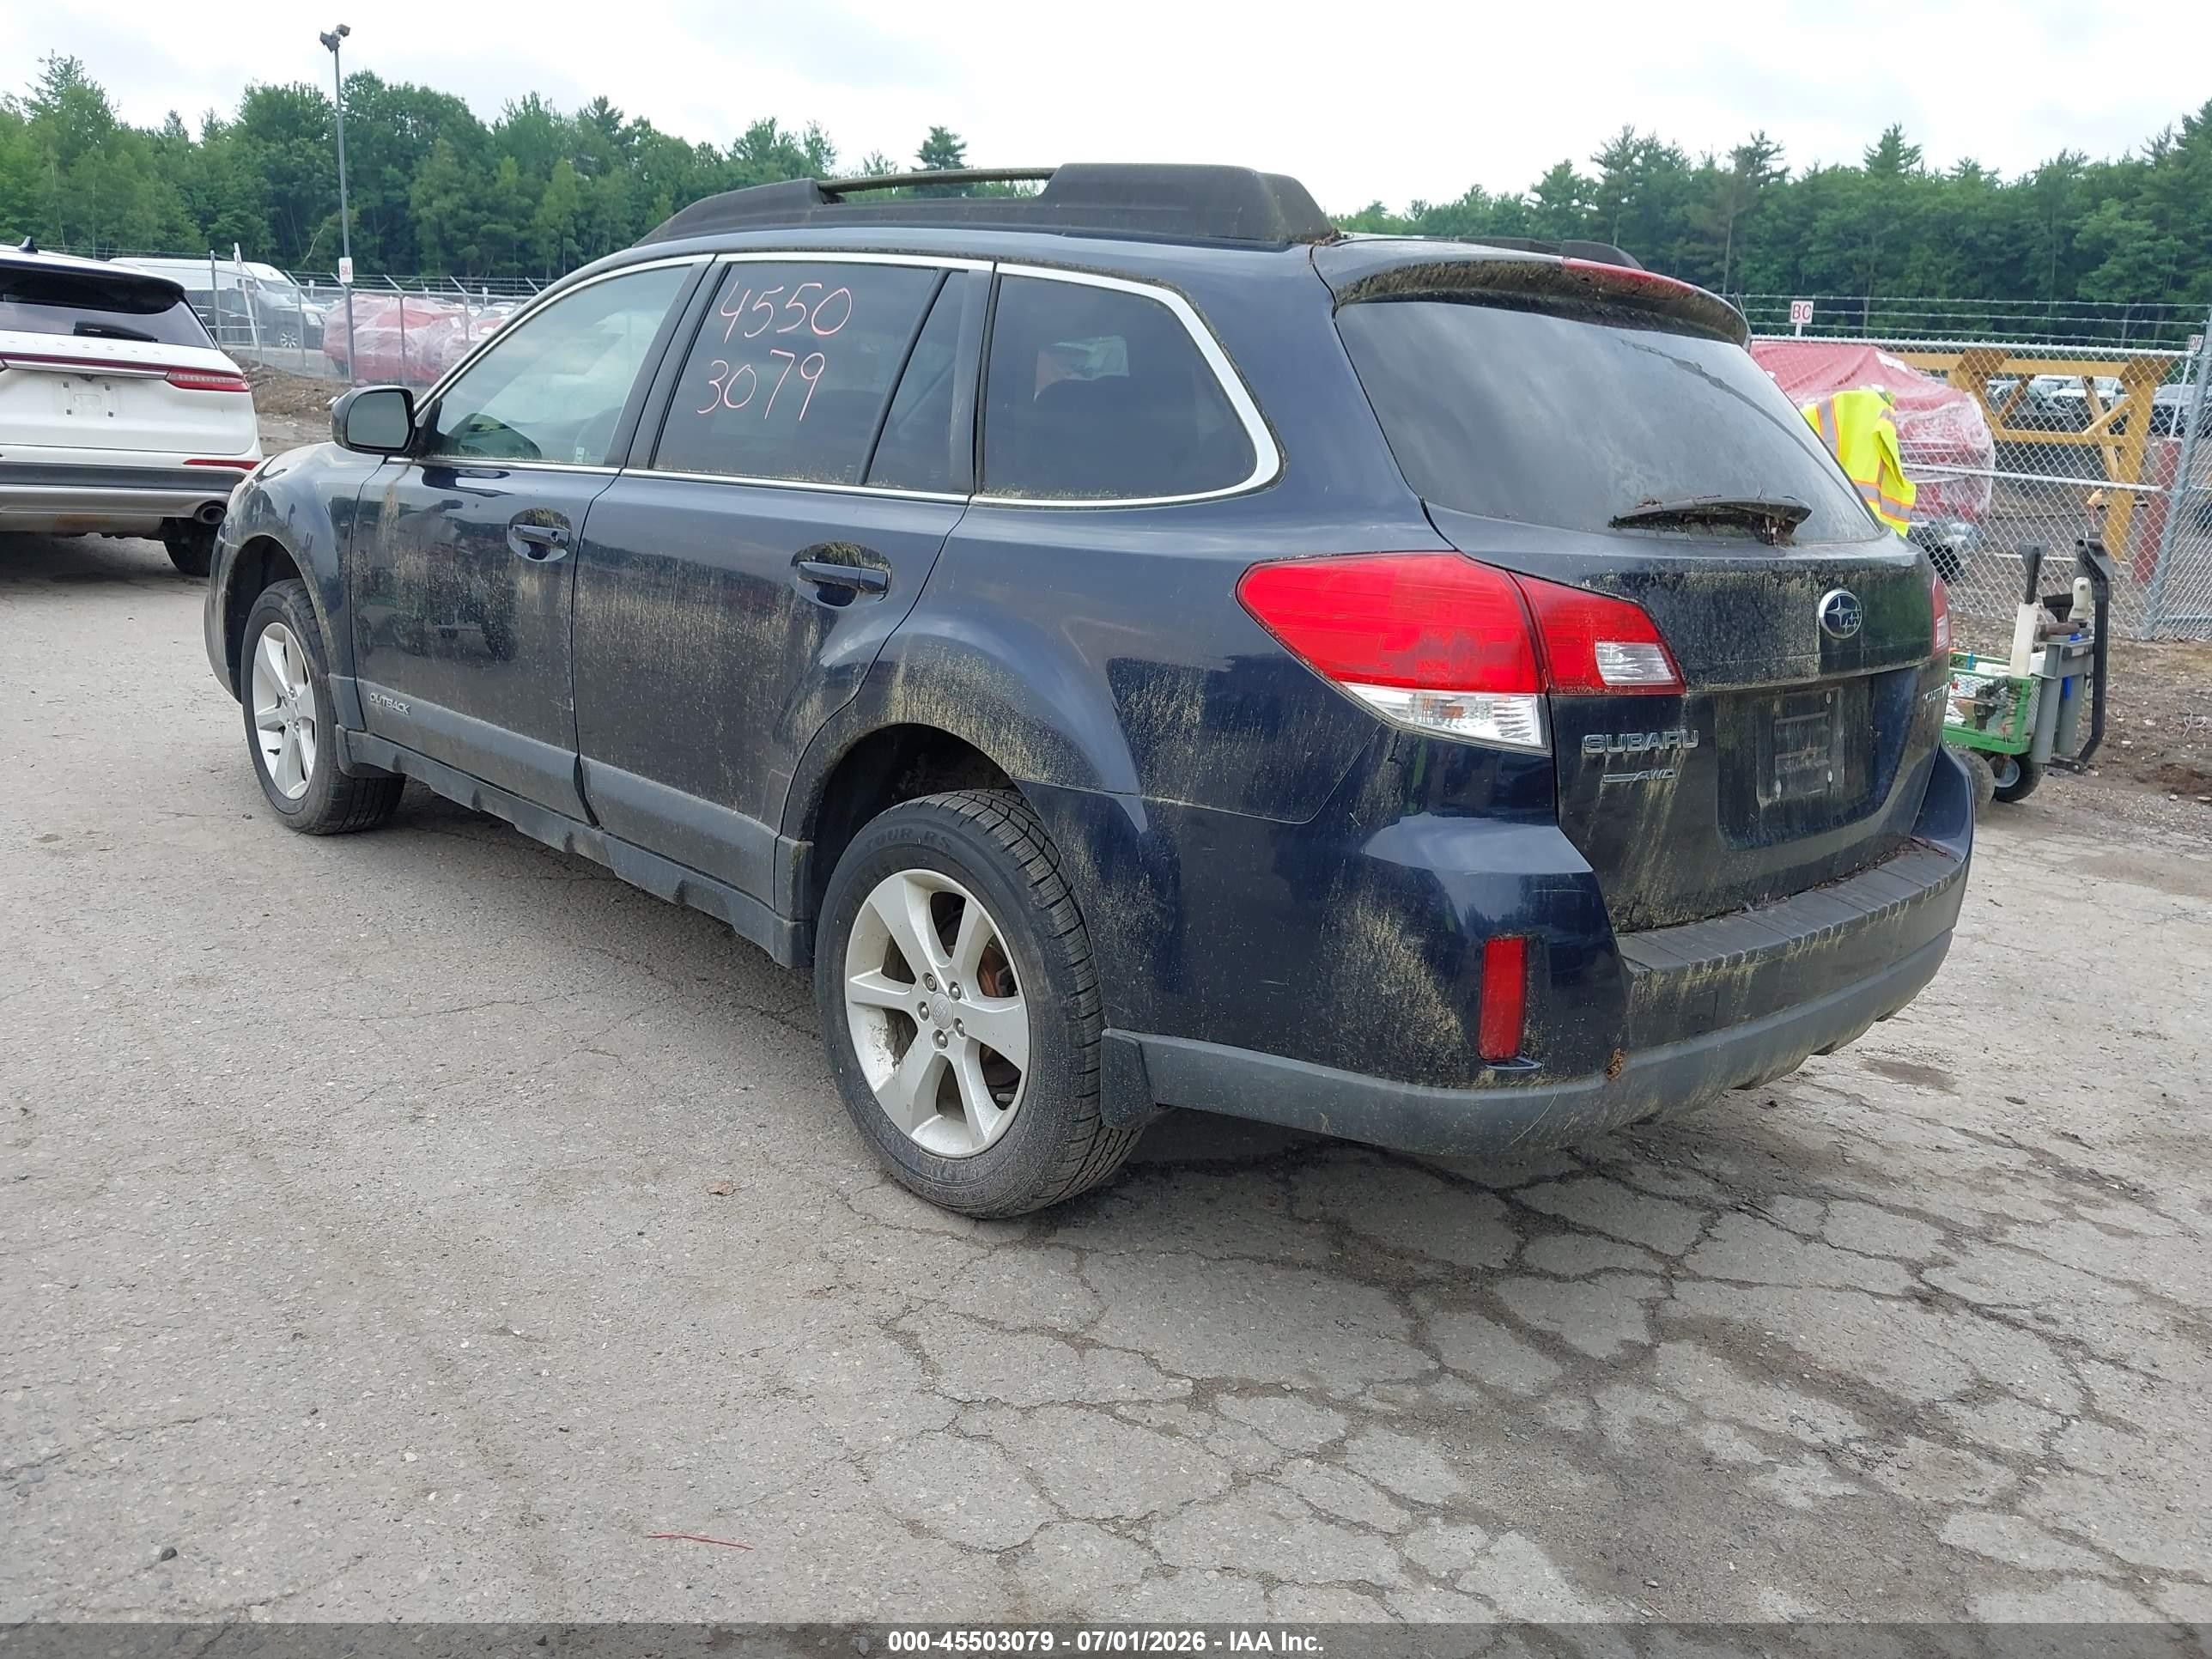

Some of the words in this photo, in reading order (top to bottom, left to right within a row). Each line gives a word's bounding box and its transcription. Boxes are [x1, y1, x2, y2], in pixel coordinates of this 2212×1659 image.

[720, 281, 853, 343] 4550
[1792, 304, 1812, 319] BC
[696, 349, 826, 422] 3079
[369, 692, 411, 715] OUTBACK
[1583, 729, 1699, 753] SUBARU
[1632, 769, 1675, 782] AWD
